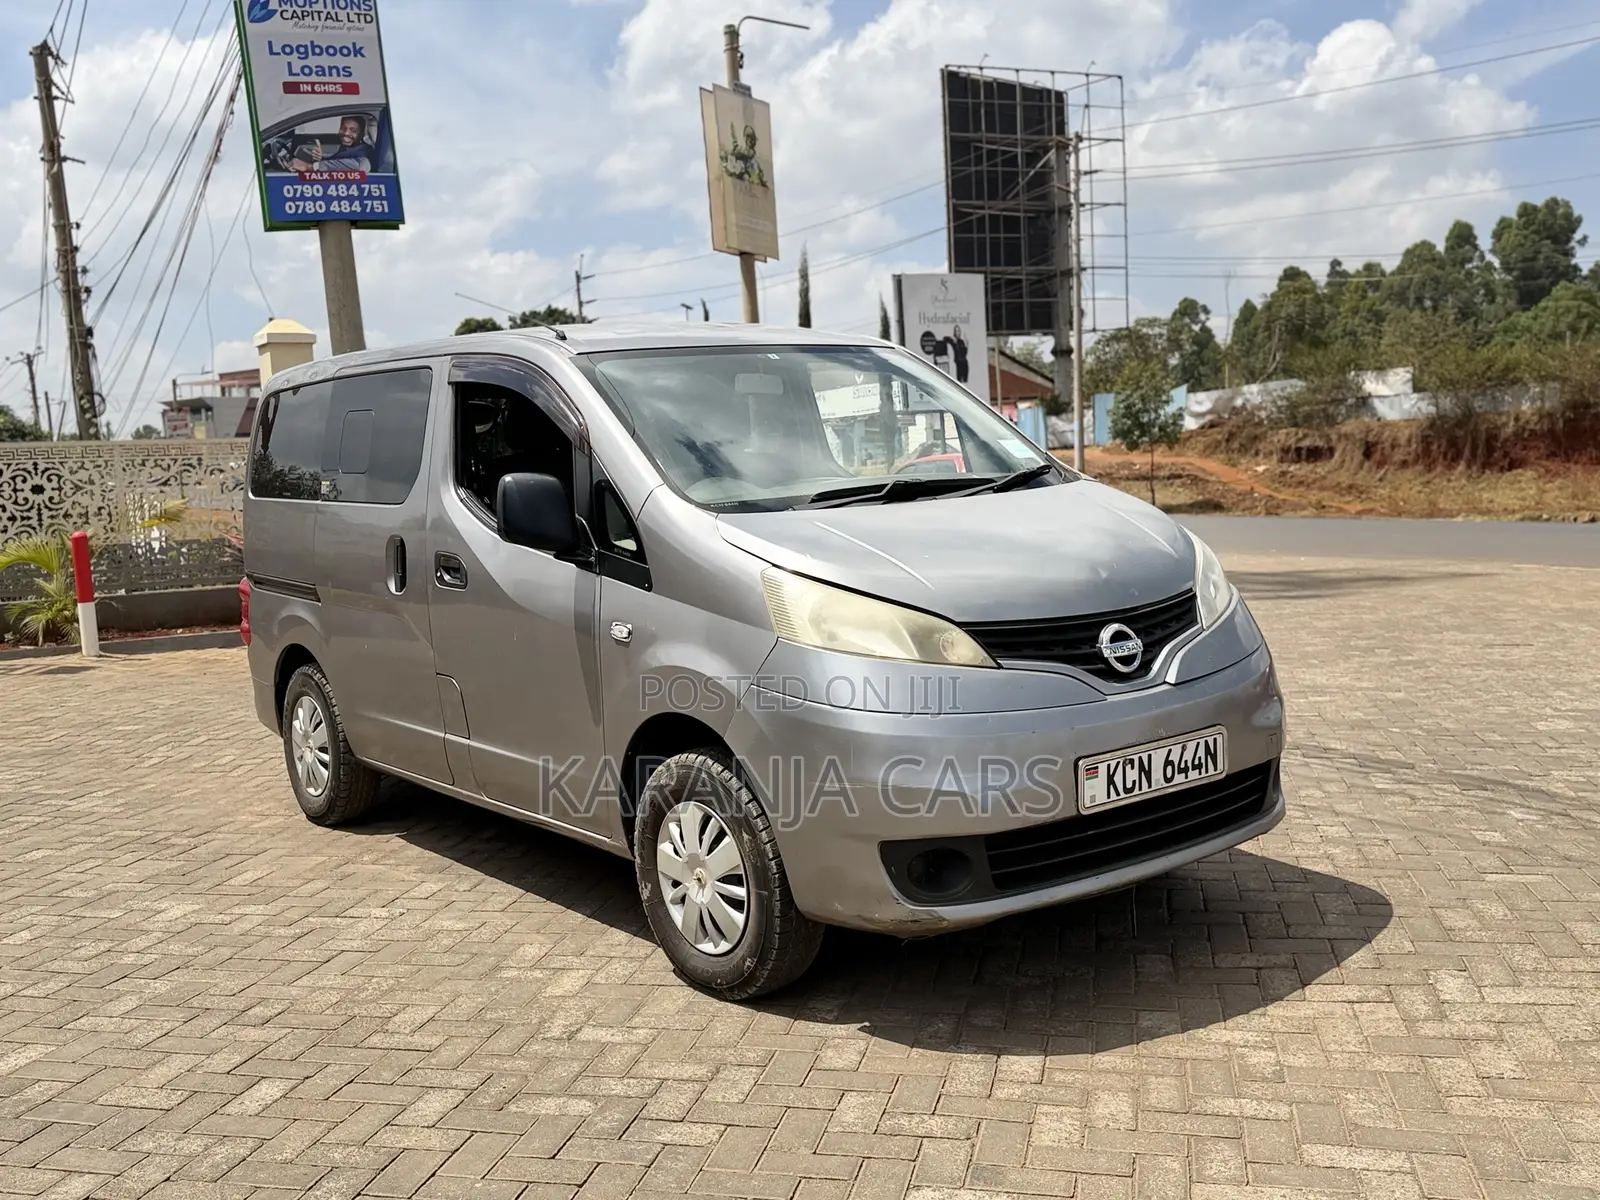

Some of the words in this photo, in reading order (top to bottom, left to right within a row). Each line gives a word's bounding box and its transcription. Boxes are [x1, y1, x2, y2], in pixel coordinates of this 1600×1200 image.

[280, 9, 343, 22] CAPITAL
[346, 12, 374, 24] LTD
[267, 40, 366, 60] Logbook
[287, 61, 353, 78] Loans
[300, 84, 312, 92] IN
[314, 84, 342, 93] 6HRS
[304, 172, 330, 180] TALK
[332, 172, 344, 180] TO
[348, 172, 361, 180] US
[283, 184, 324, 198] 0790
[327, 185, 359, 197] 484
[361, 184, 386, 197] 751
[285, 200, 326, 214] 0780
[330, 200, 362, 214] 484
[363, 200, 389, 213] 751
[918, 312, 971, 328] Hydrafacial
[1109, 642, 1142, 655] NISSAN
[1106, 753, 1153, 800] KCN
[1162, 737, 1219, 785] 644N
